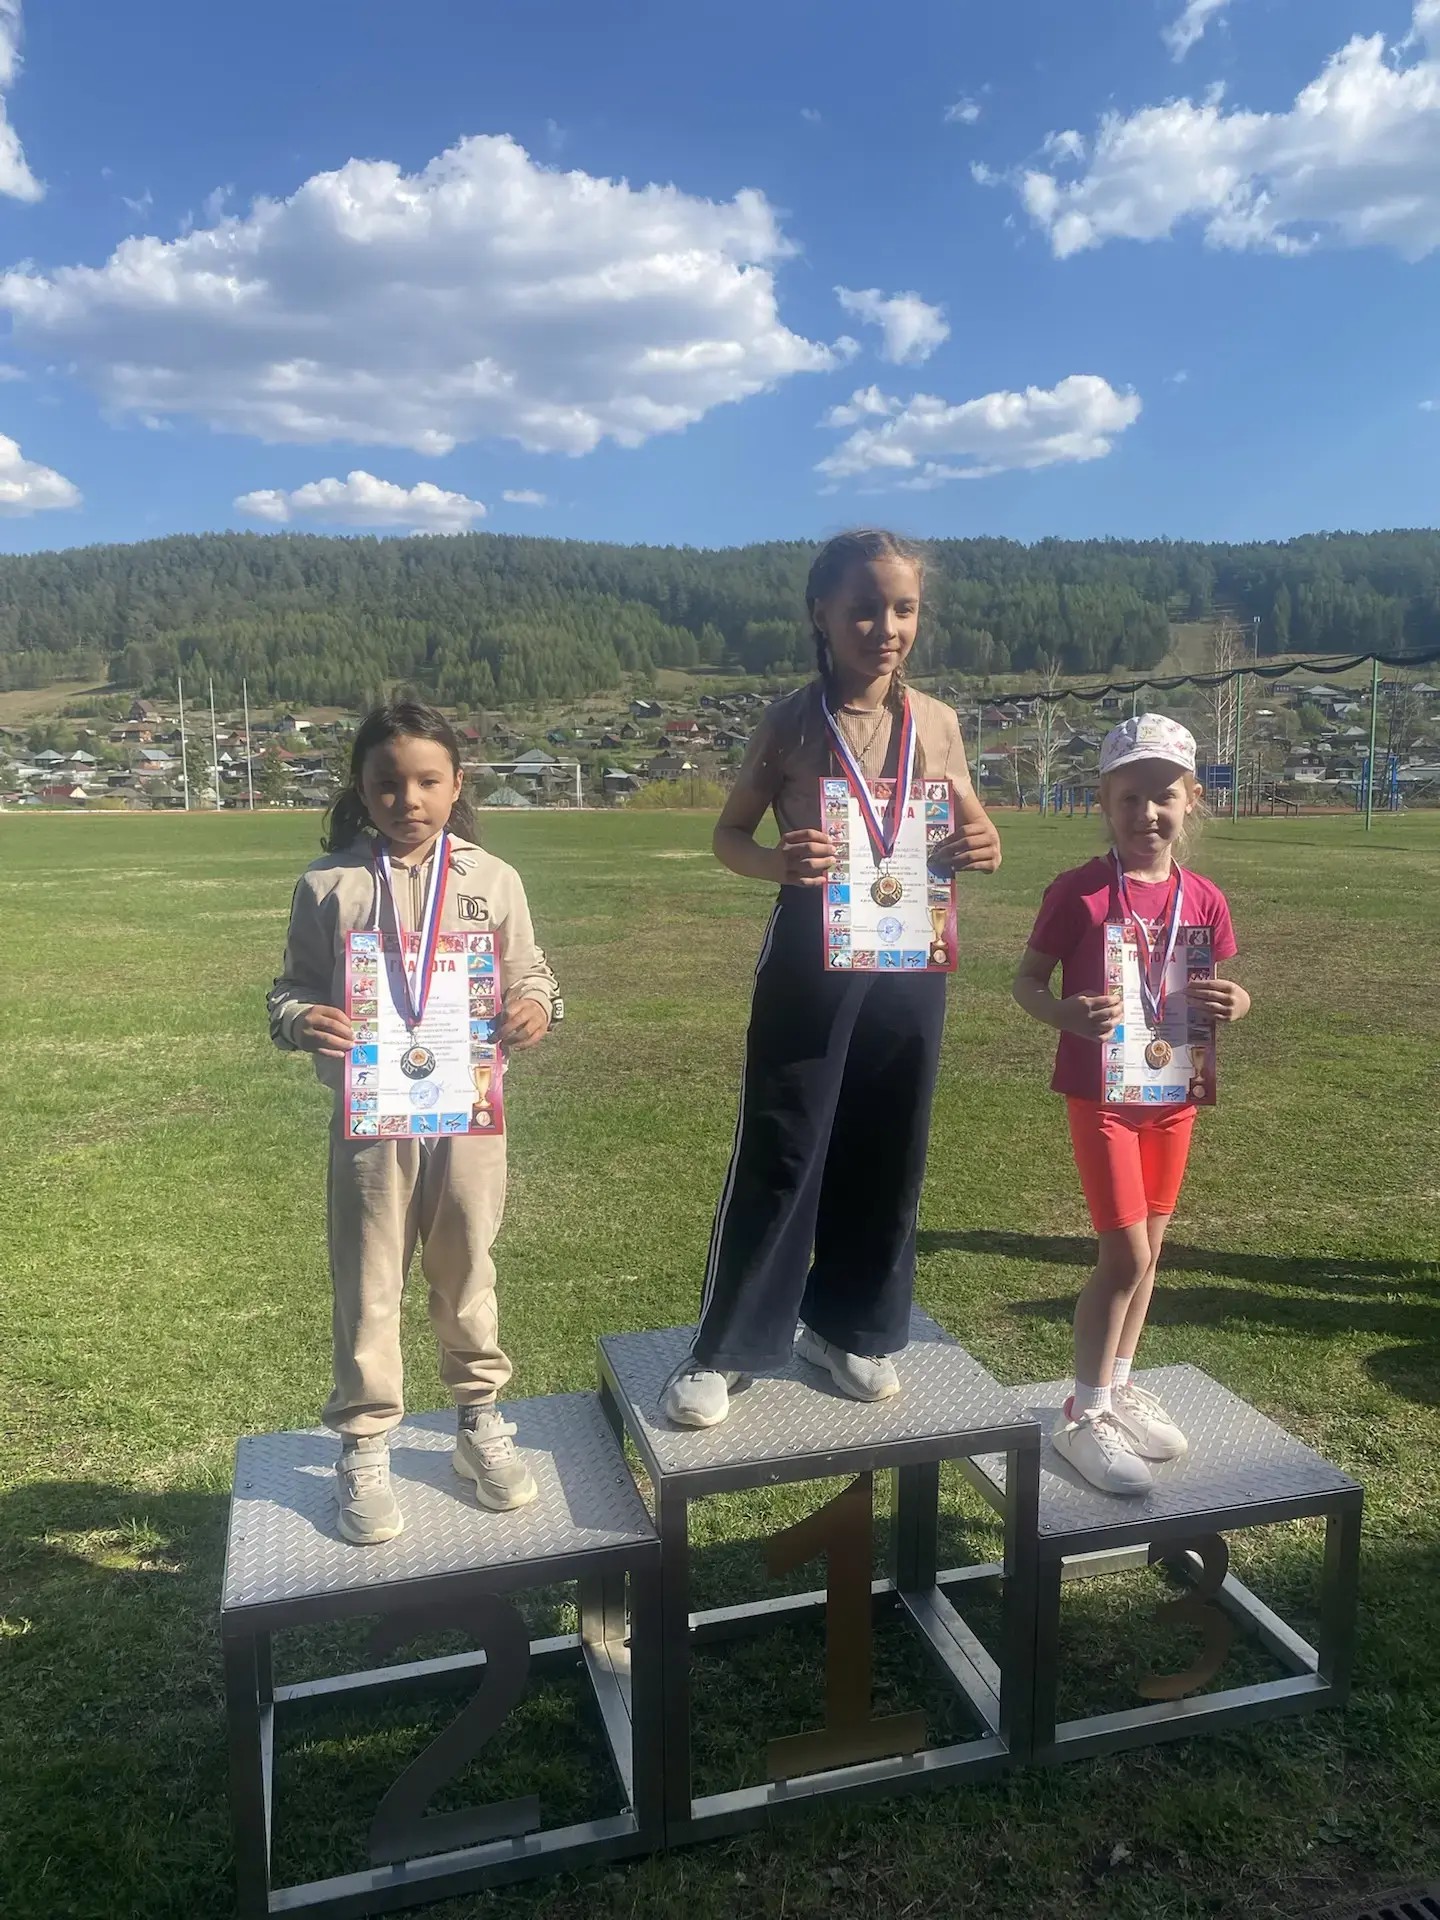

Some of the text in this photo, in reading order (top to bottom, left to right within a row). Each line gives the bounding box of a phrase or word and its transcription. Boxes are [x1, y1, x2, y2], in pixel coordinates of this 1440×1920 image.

[457, 893, 488, 921] DG
[767, 1471, 926, 1780] 1
[1138, 1534, 1233, 1699] 3
[370, 1593, 540, 1864] 2
